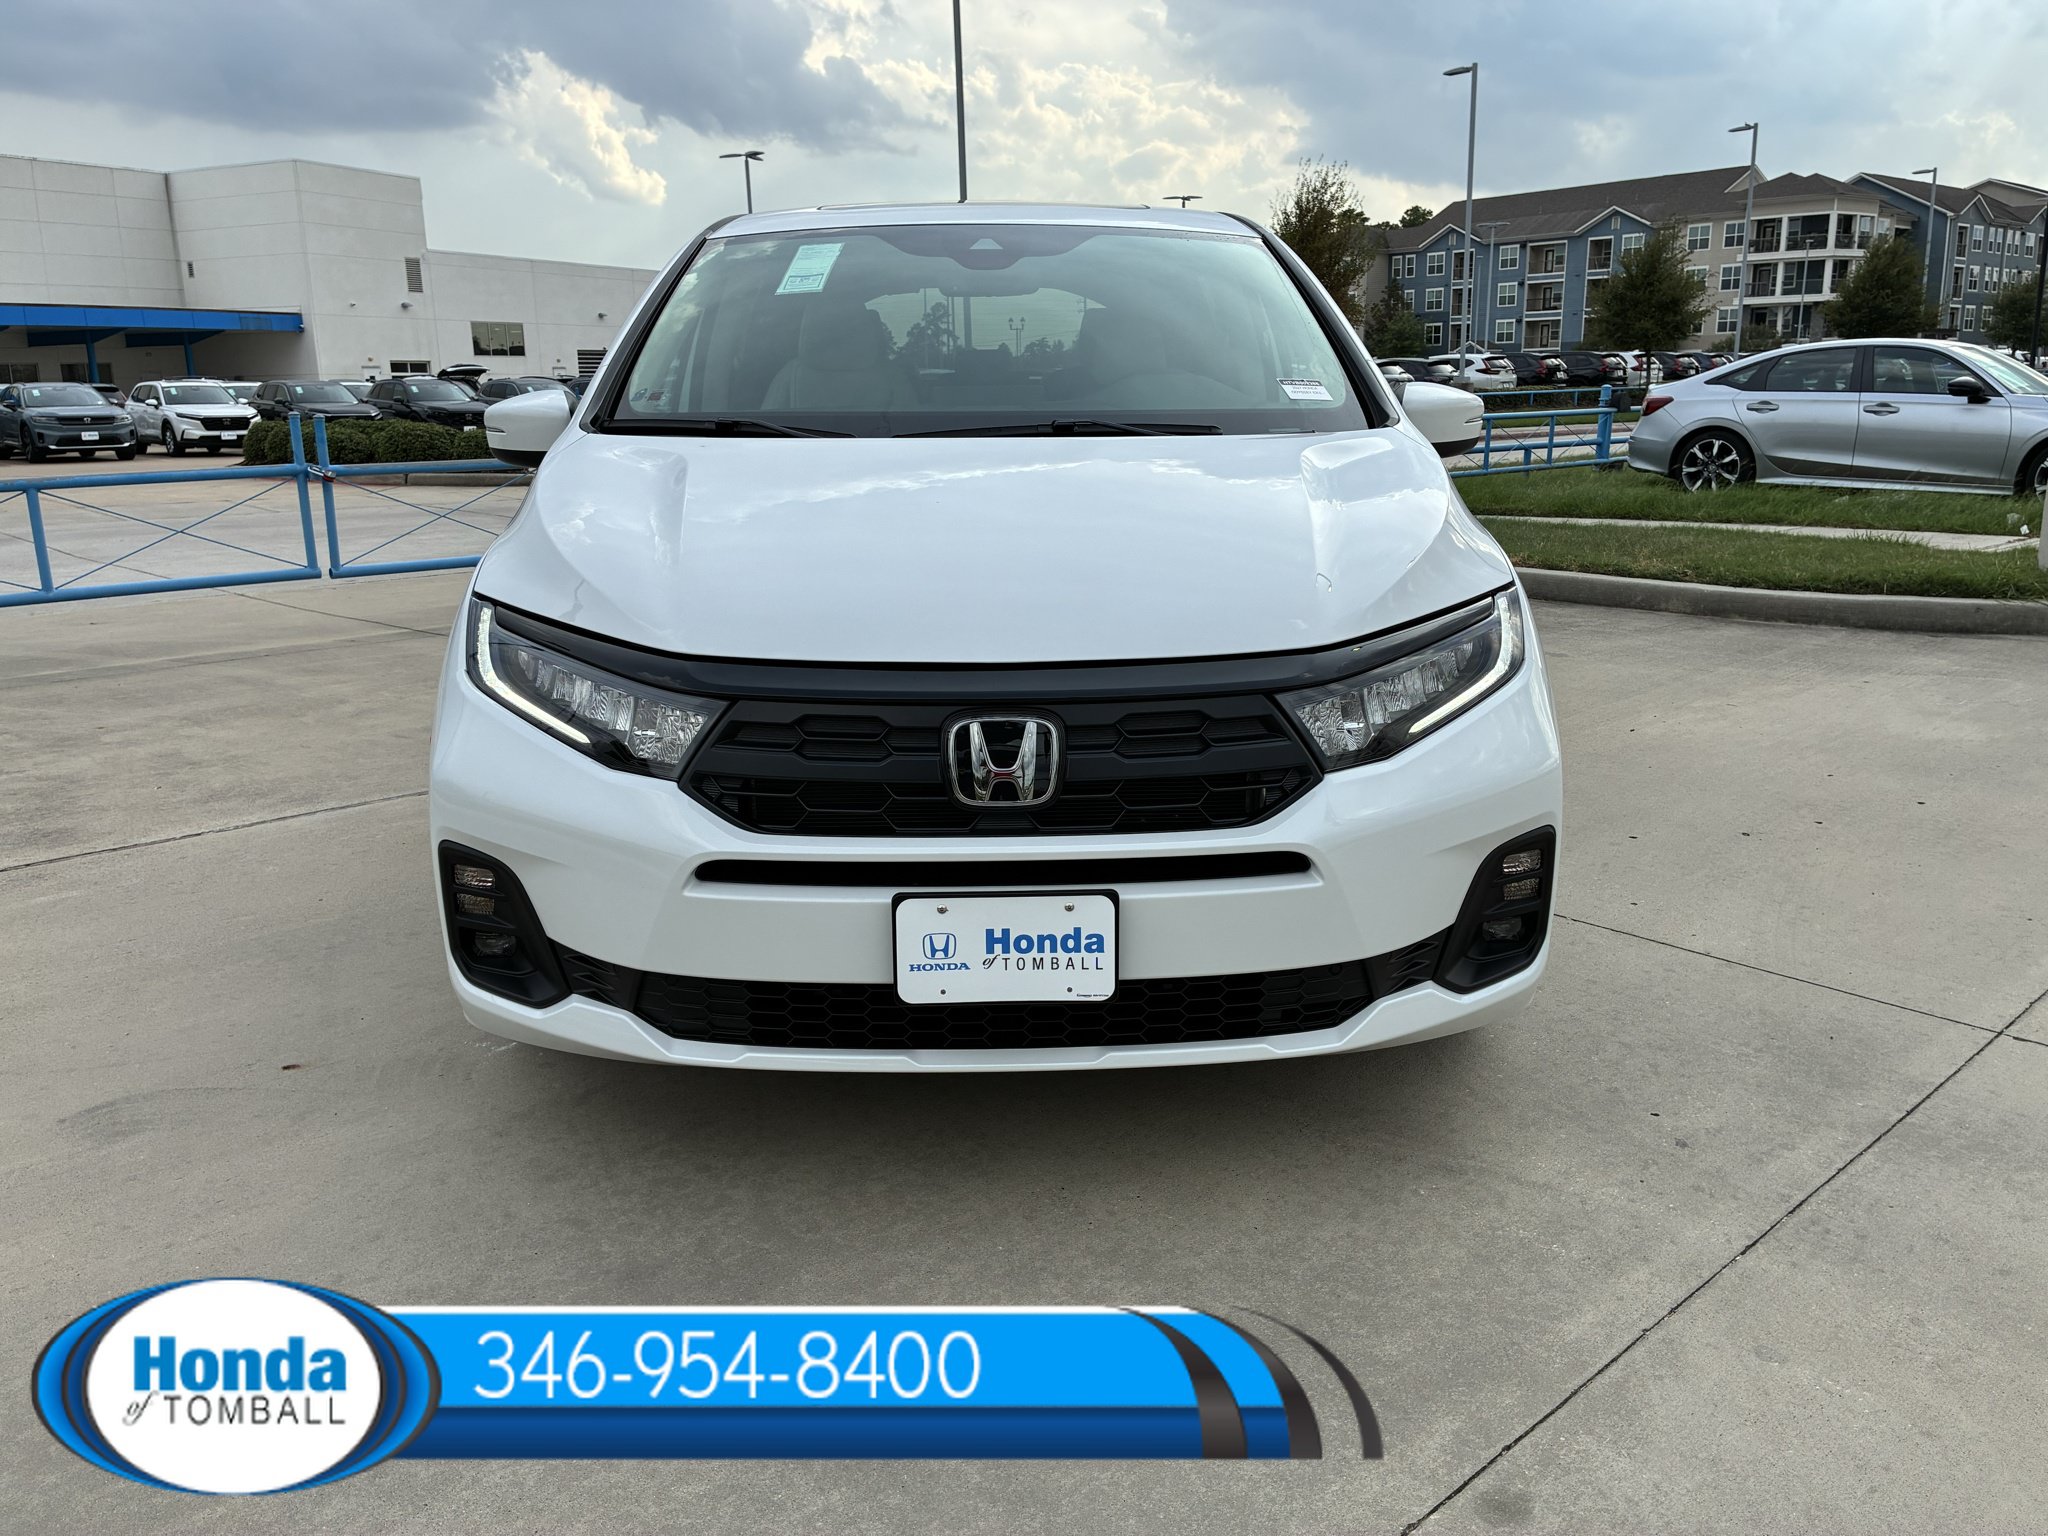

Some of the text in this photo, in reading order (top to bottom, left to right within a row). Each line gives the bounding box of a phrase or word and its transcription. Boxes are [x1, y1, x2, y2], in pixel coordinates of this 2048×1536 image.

[985, 927, 1105, 954] Honda
[909, 963, 971, 972] HONDA
[982, 954, 1104, 971] of TOMBALL
